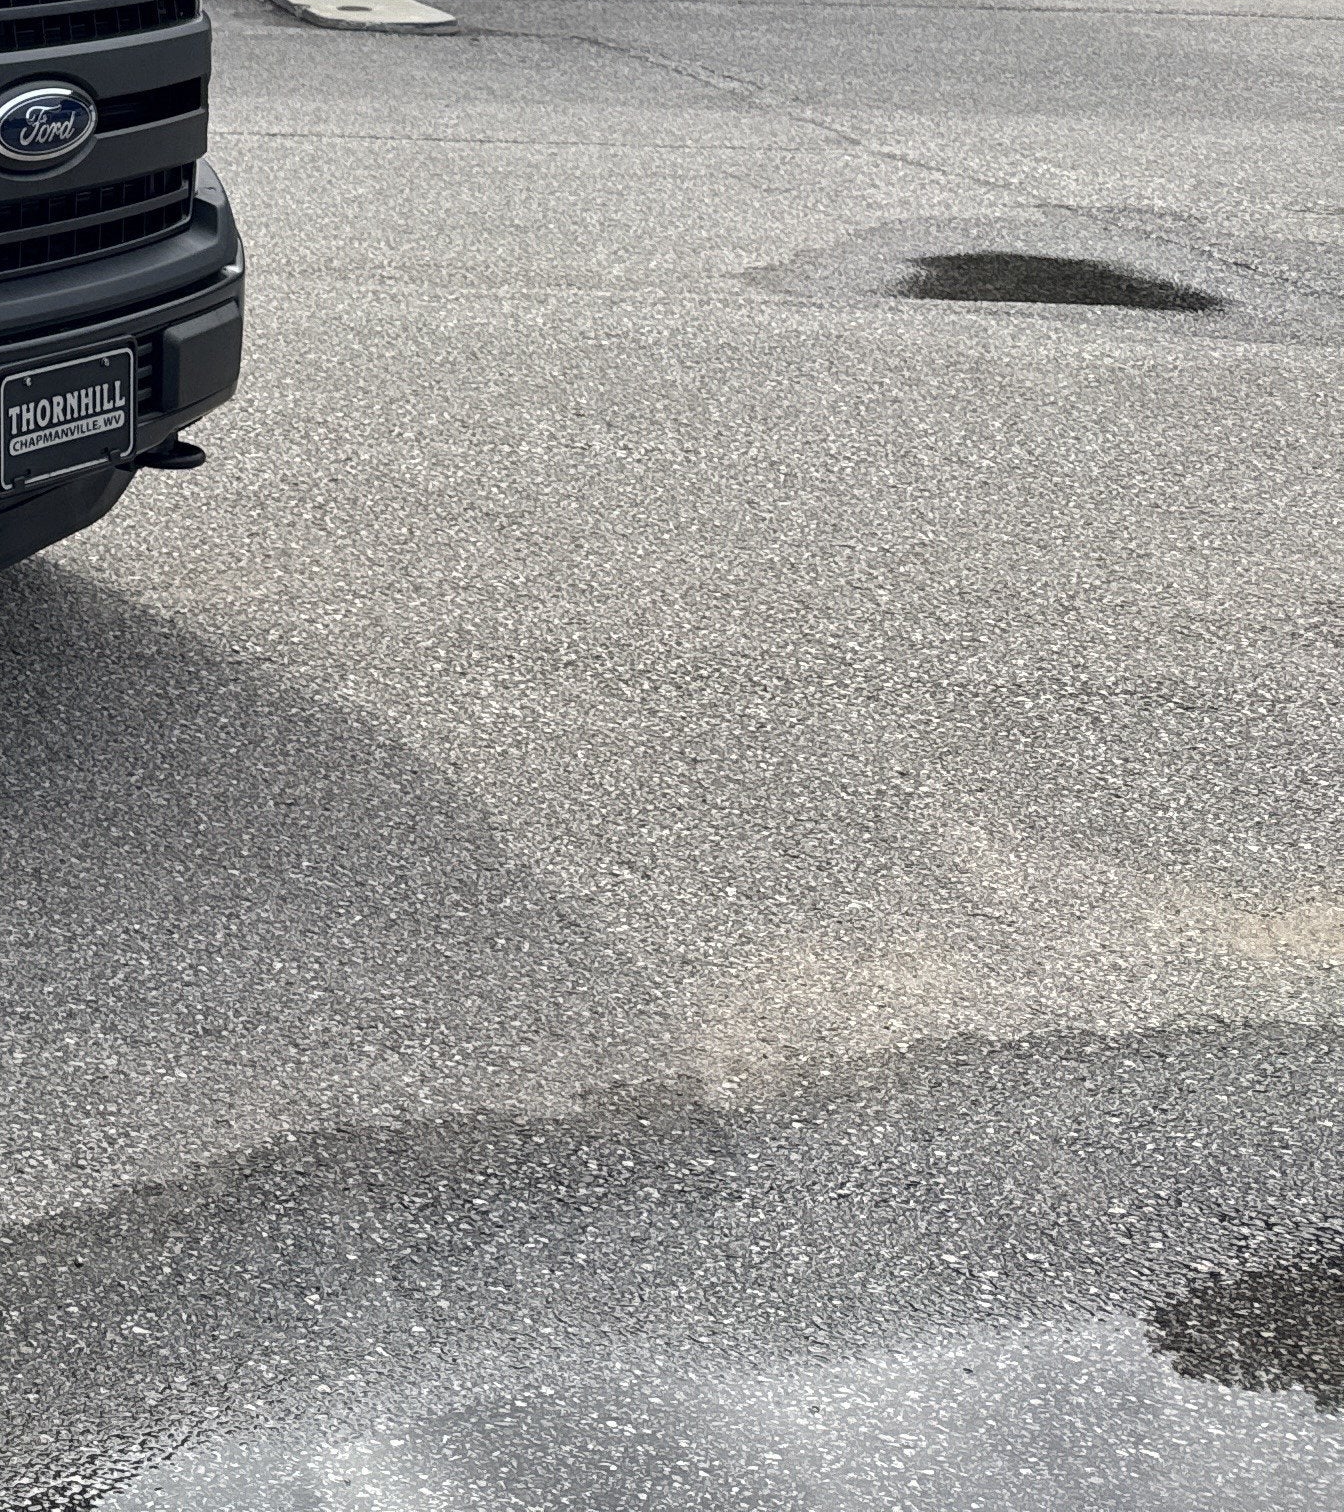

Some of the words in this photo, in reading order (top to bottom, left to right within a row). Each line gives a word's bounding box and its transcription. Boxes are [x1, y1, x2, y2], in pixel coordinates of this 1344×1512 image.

[20, 104, 76, 146] Ford
[8, 380, 126, 435] THORNHILL
[103, 413, 122, 428] WV
